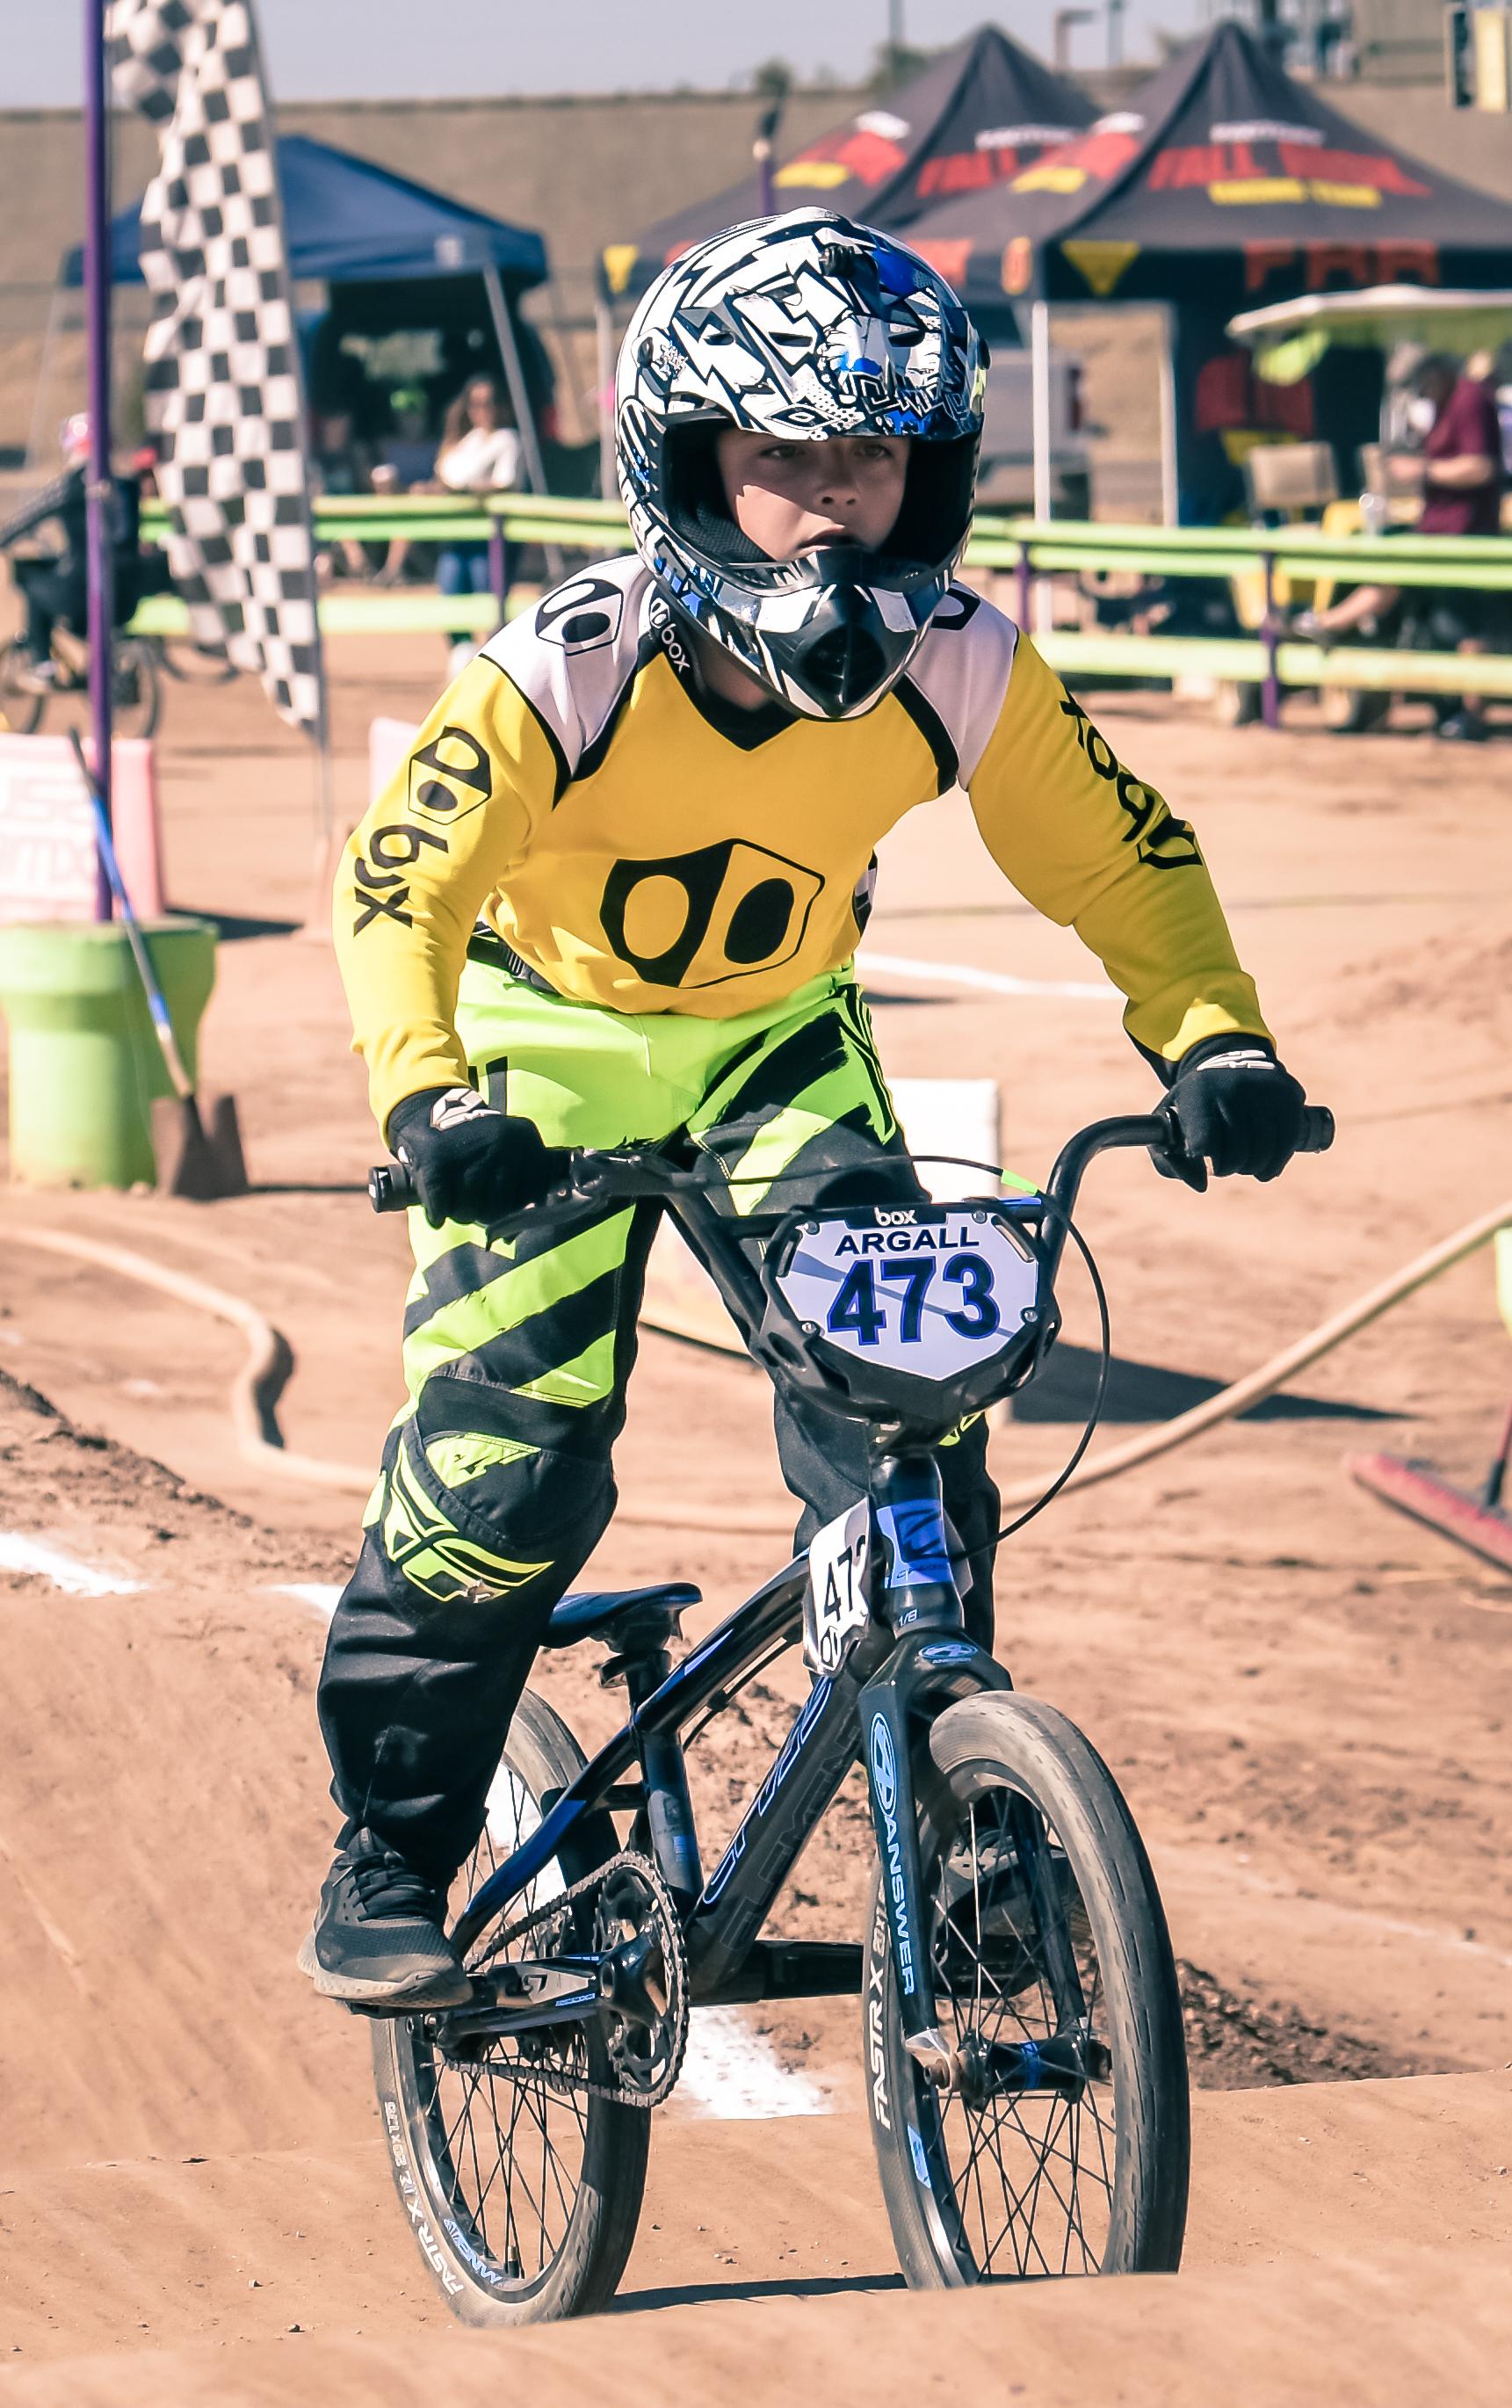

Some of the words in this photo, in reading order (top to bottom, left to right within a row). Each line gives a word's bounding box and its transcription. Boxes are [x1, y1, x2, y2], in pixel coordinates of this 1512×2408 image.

[661, 623, 691, 674] box
[834, 1226, 980, 1257] ARGALL
[873, 1207, 918, 1227] box
[826, 1251, 1001, 1346] 473
[883, 1815, 917, 1996] ANSWER
